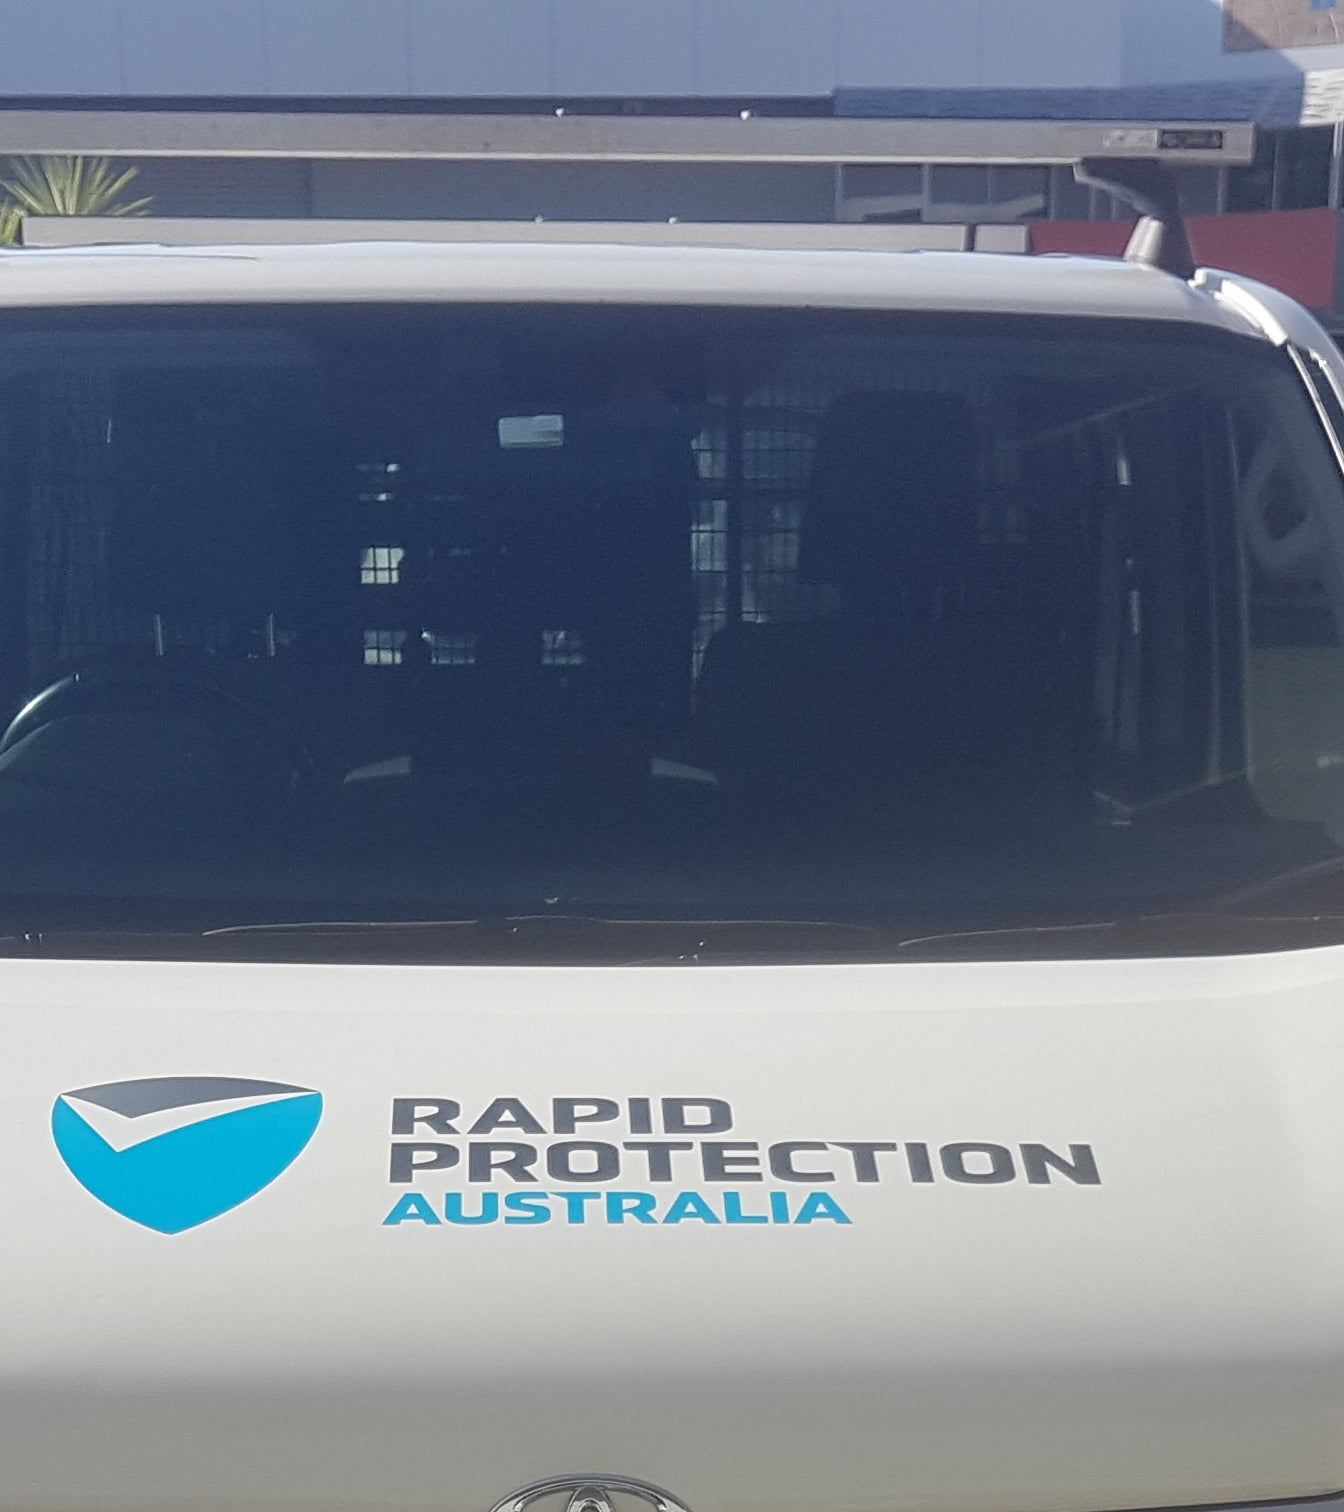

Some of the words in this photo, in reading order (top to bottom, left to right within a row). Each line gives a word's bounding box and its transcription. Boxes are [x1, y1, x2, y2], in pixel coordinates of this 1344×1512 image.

[389, 1096, 733, 1135] RAPID
[388, 1139, 1103, 1187] PROTECTION
[380, 1190, 854, 1227] AUSTRALIA
